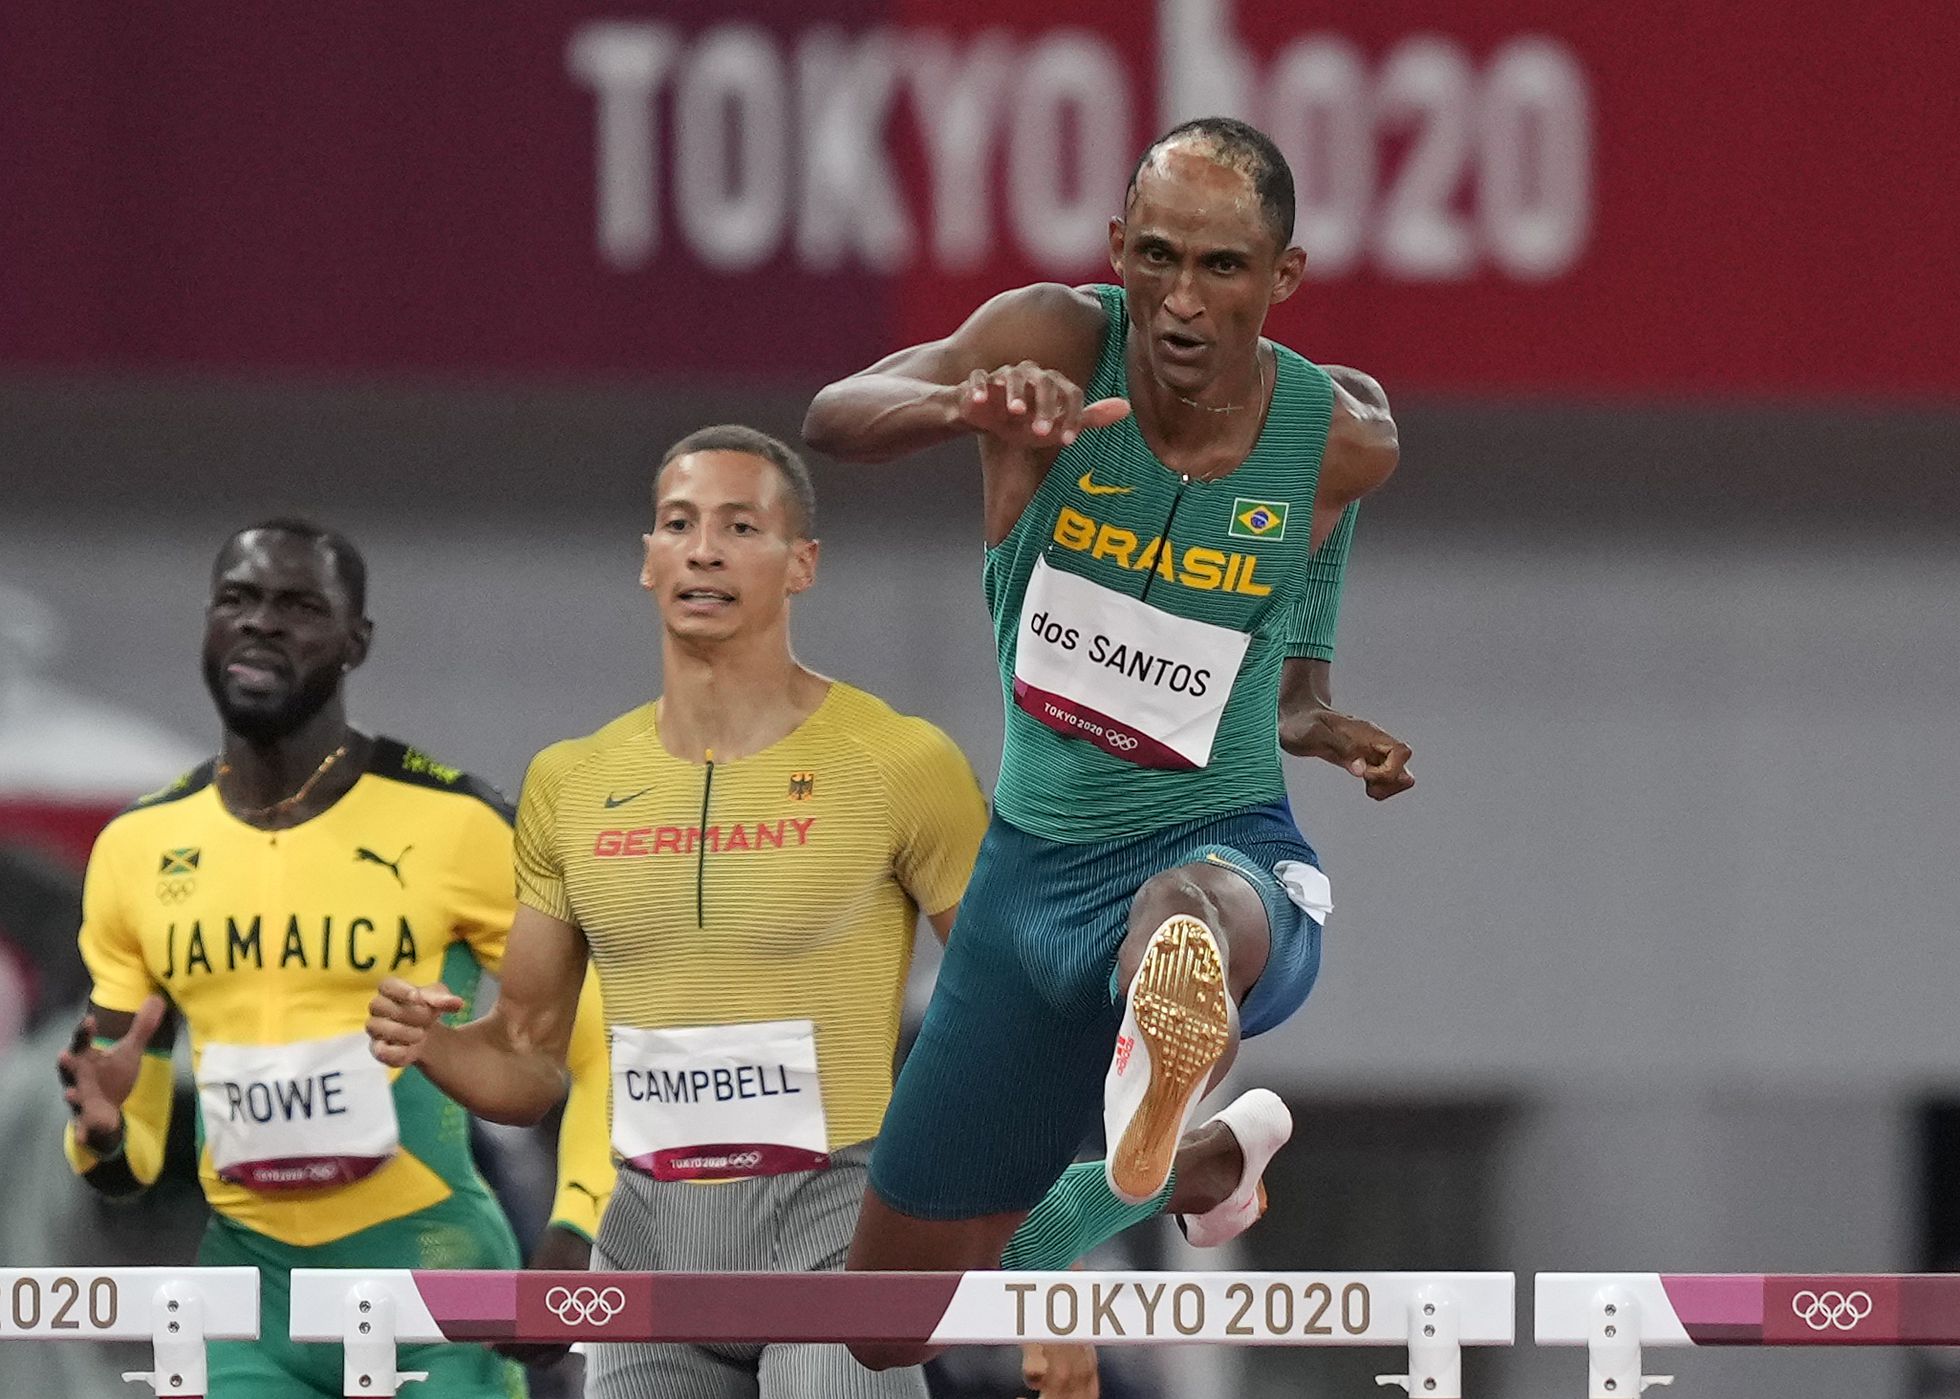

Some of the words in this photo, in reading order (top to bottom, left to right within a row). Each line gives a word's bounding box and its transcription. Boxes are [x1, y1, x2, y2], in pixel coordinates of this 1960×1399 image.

[566, 20, 1138, 276] TOKYO
[1180, 33, 1593, 280] 020
[1052, 506, 1273, 597] BRASIL
[1030, 611, 1080, 651] dos
[1088, 634, 1212, 698] SANTOS
[1044, 702, 1077, 726] TOKYO
[1077, 718, 1104, 737] 2020
[594, 816, 816, 858] GERMANY
[161, 914, 418, 980] JAMAICA
[225, 1071, 347, 1124] ROWE
[626, 1063, 801, 1104] CAMPBELL
[0, 1276, 118, 1330] 020
[1005, 1283, 1205, 1335] TOKYO
[1225, 1283, 1371, 1335] 2020
